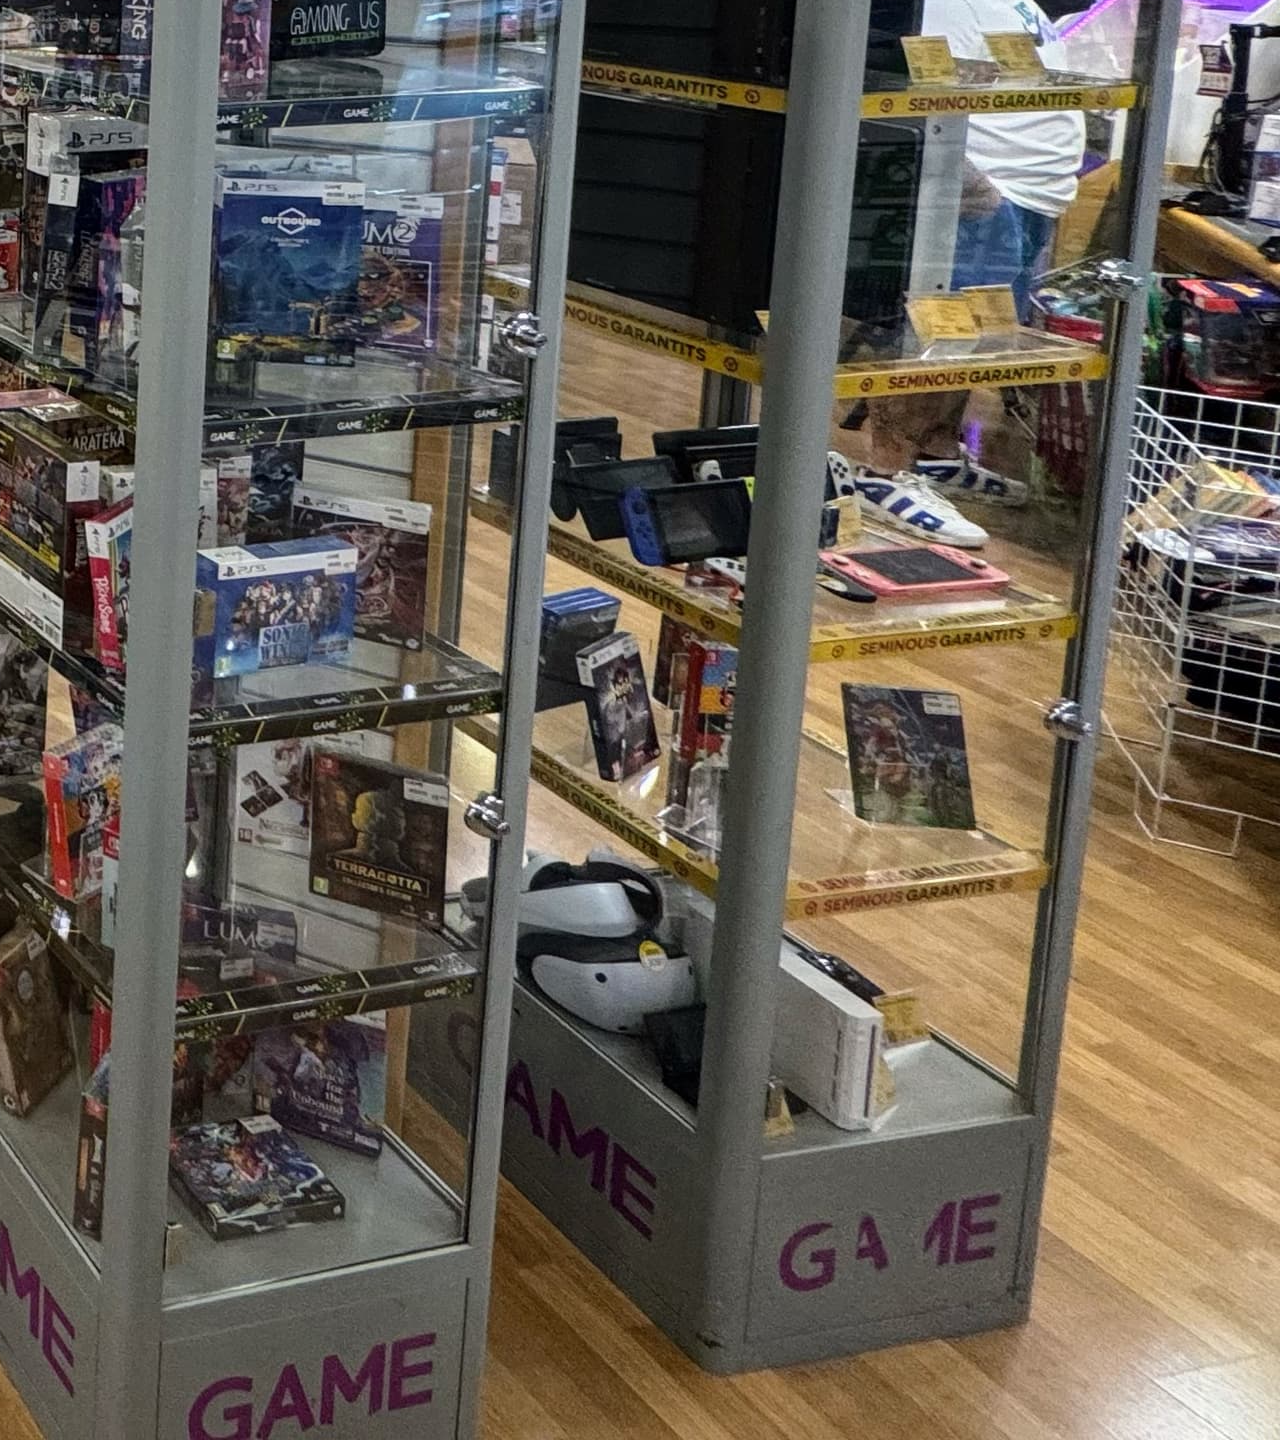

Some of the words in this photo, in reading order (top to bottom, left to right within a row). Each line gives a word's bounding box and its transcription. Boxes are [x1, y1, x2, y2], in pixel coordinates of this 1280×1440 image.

[291, 3, 349, 35] AMONG
[359, 1, 380, 28] US
[582, 64, 627, 83] NOUS
[629, 71, 728, 99] GARANTITS
[485, 100, 510, 111] GAME
[908, 94, 990, 111] SEMINOUS
[992, 92, 1083, 108] GARANTITS
[343, 108, 369, 118] GAME
[89, 132, 133, 144] PS5
[244, 183, 278, 192] PS5
[261, 216, 321, 226] OUTBOUND
[565, 306, 608, 329] NOUS
[611, 320, 707, 361] GARANTITS
[888, 372, 966, 390] SEMINOUS
[969, 365, 1056, 383] GARANTITS
[474, 409, 498, 419] GAME
[337, 420, 362, 430] GAME
[210, 431, 236, 441] GAME
[237, 563, 266, 574] PS5
[592, 563, 685, 616] GARANTITS
[858, 636, 938, 656] SEMINOUS
[940, 628, 1025, 646] GARANTITS
[447, 703, 470, 713] GAME
[313, 720, 337, 731] GAME
[334, 858, 422, 892] TERRACOTTA
[823, 890, 904, 912] SEMINOUS
[905, 878, 996, 903] GARANTITS
[424, 987, 448, 997] GAME
[293, 1011, 317, 1020] GAME
[187, 1332, 437, 1440] GAME
